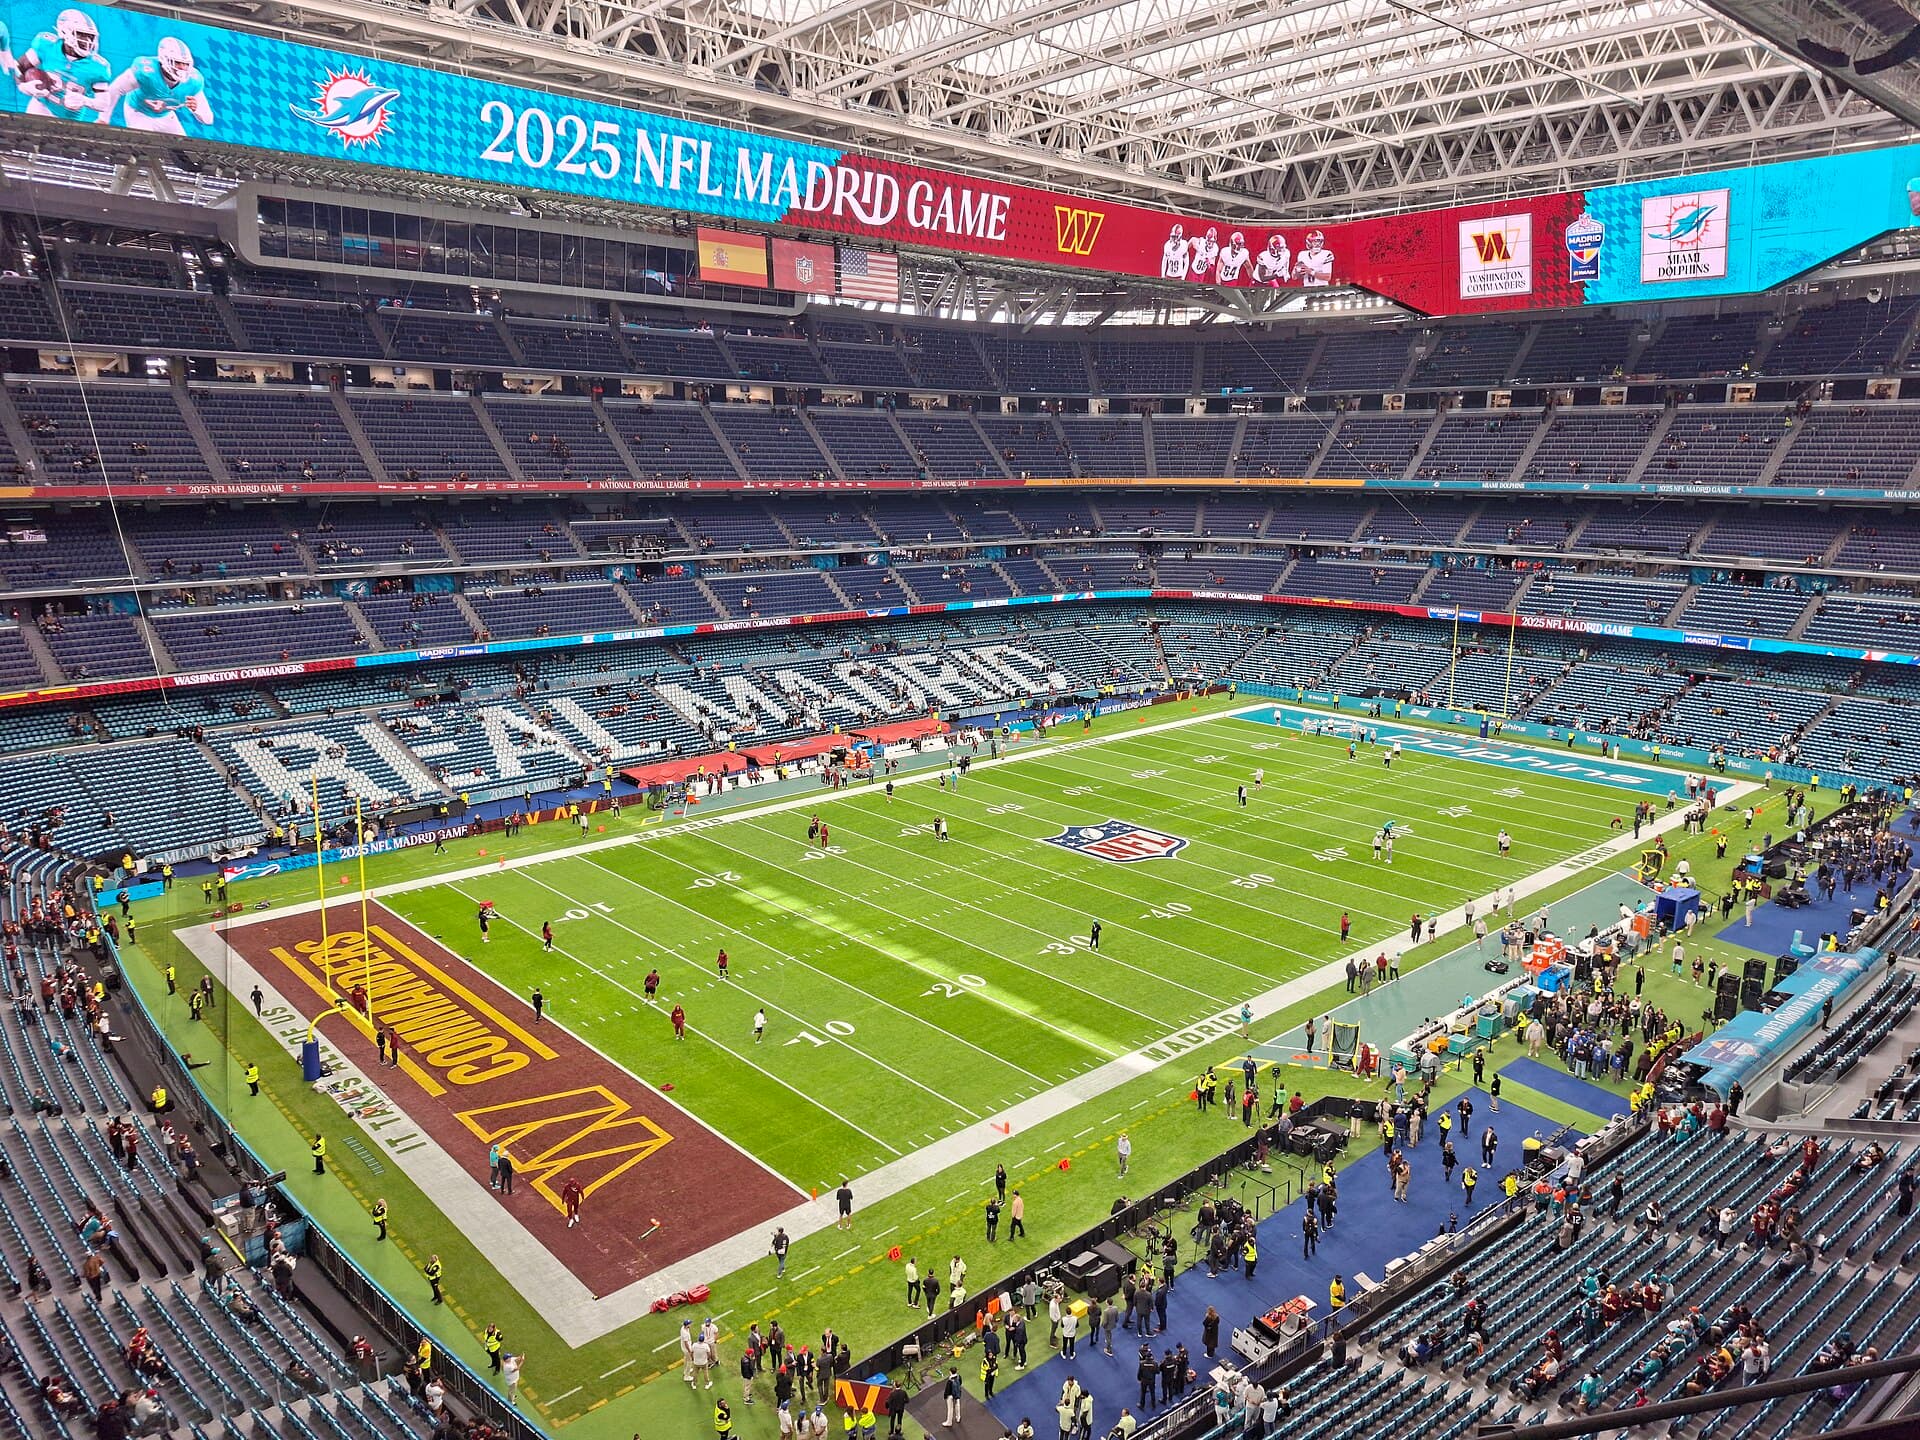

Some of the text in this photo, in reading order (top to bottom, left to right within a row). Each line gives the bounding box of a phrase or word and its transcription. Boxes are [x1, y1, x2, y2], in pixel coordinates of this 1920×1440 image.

[480, 100, 1012, 241] 2025 NFL MADRID GAME
[1568, 235, 1602, 244] MADRID
[1666, 252, 1700, 265] MIAMI
[1223, 264, 1237, 279] 54
[1468, 270, 1523, 284] WASHINGTON
[1658, 263, 1710, 277] DOLPHINS
[1466, 279, 1526, 294] COMMANDERS
[188, 484, 285, 494] 2025 NFL MADRID GAME
[599, 480, 690, 489] NATIONAL FOOTBALL LEAGUE
[1673, 485, 1685, 493] NFL
[1685, 485, 1710, 494] MADRID
[1711, 486, 1731, 494] GAME
[1883, 490, 1907, 499] MIAMI
[1192, 591, 1263, 601] WASHINGTON COMMANDERS
[713, 617, 791, 632] WASHINGTON COMMANDERS
[1521, 616, 1634, 637] 2025 NFL MADRID GAME
[1685, 636, 1717, 646] MADRID
[419, 647, 455, 657] MADRID
[173, 663, 304, 687] WASHINGTON COMMANDERS
[231, 643, 1068, 806] REAL MADRID
[1488, 720, 1527, 733] Dphins
[1587, 735, 1602, 744] VISA
[1377, 734, 1654, 785] Dolphins
[489, 784, 515, 799] 2025
[516, 783, 534, 795] NFL
[986, 803, 1025, 815] 50
[1436, 804, 1474, 818] 20
[633, 817, 723, 841] MADRID
[370, 838, 392, 853] NFL
[392, 830, 437, 851] MADRID
[438, 826, 469, 840] GAME
[1084, 833, 1178, 861] NFL
[163, 844, 206, 865] MIAMI
[1311, 846, 1347, 862] 40
[1560, 845, 1622, 871] MADRID
[690, 870, 742, 890] 20
[1229, 873, 1276, 890] 50
[565, 900, 616, 921] 10
[1150, 901, 1193, 921] 40
[930, 973, 987, 999] 20
[260, 1006, 297, 1026] US
[293, 930, 532, 1086] COMMANDERS
[798, 1019, 856, 1048] 10
[1139, 1012, 1243, 1064] MADRID
[385, 1132, 428, 1155] IT
[1572, 1214, 1583, 1225] 12
